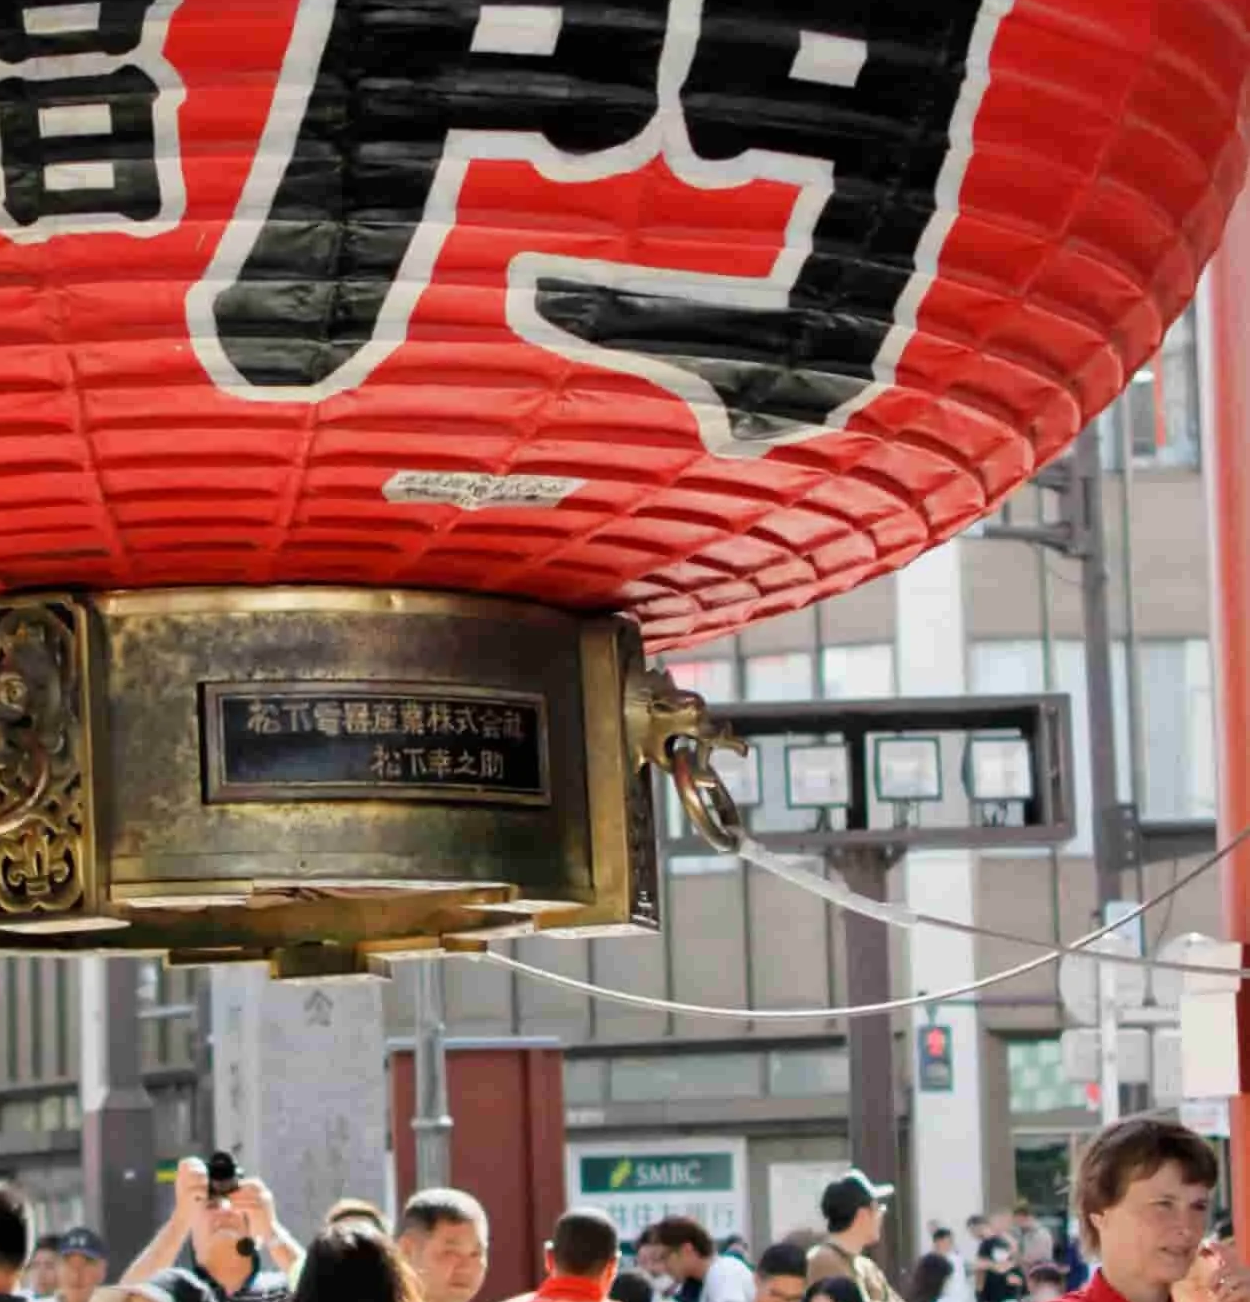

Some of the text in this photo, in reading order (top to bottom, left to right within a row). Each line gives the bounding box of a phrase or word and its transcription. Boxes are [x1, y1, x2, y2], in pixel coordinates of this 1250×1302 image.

[369, 744, 505, 782] 松下幸之助
[636, 1160, 703, 1188] SMBC
